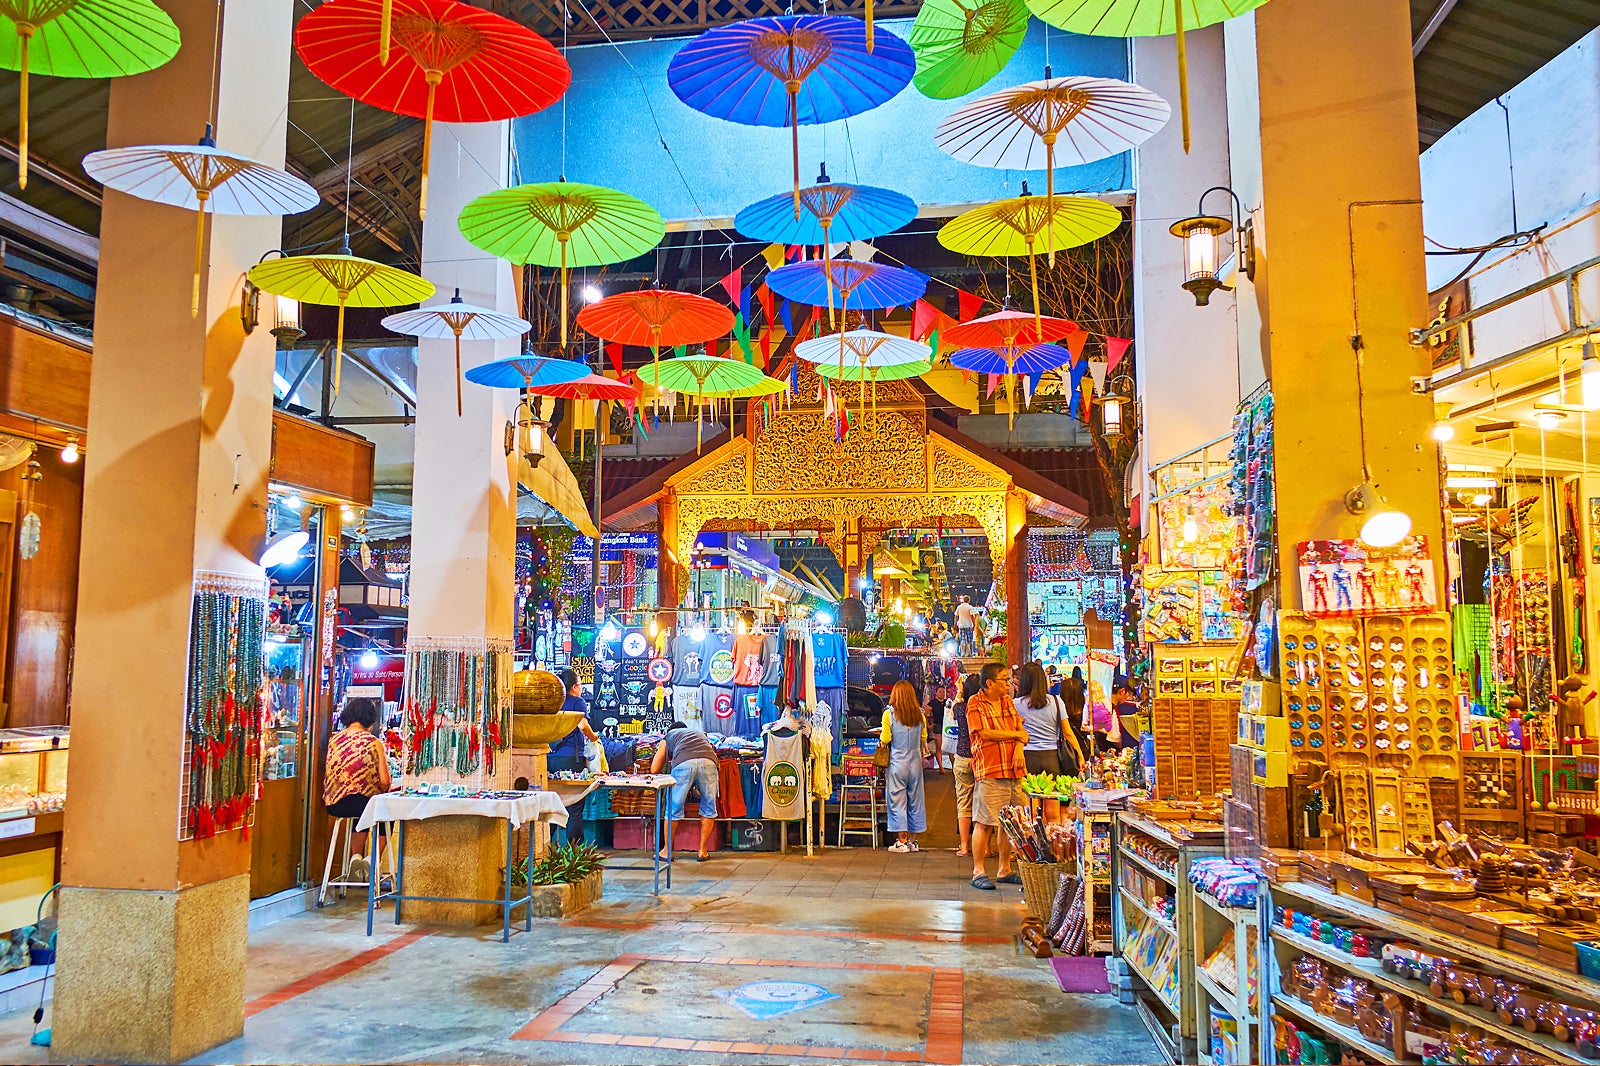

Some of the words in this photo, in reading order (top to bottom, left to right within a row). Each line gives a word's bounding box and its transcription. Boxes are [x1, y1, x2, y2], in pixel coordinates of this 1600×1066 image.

[629, 536, 649, 544] Bank
[1052, 634, 1086, 646] UNDE
[624, 664, 648, 672] Google
